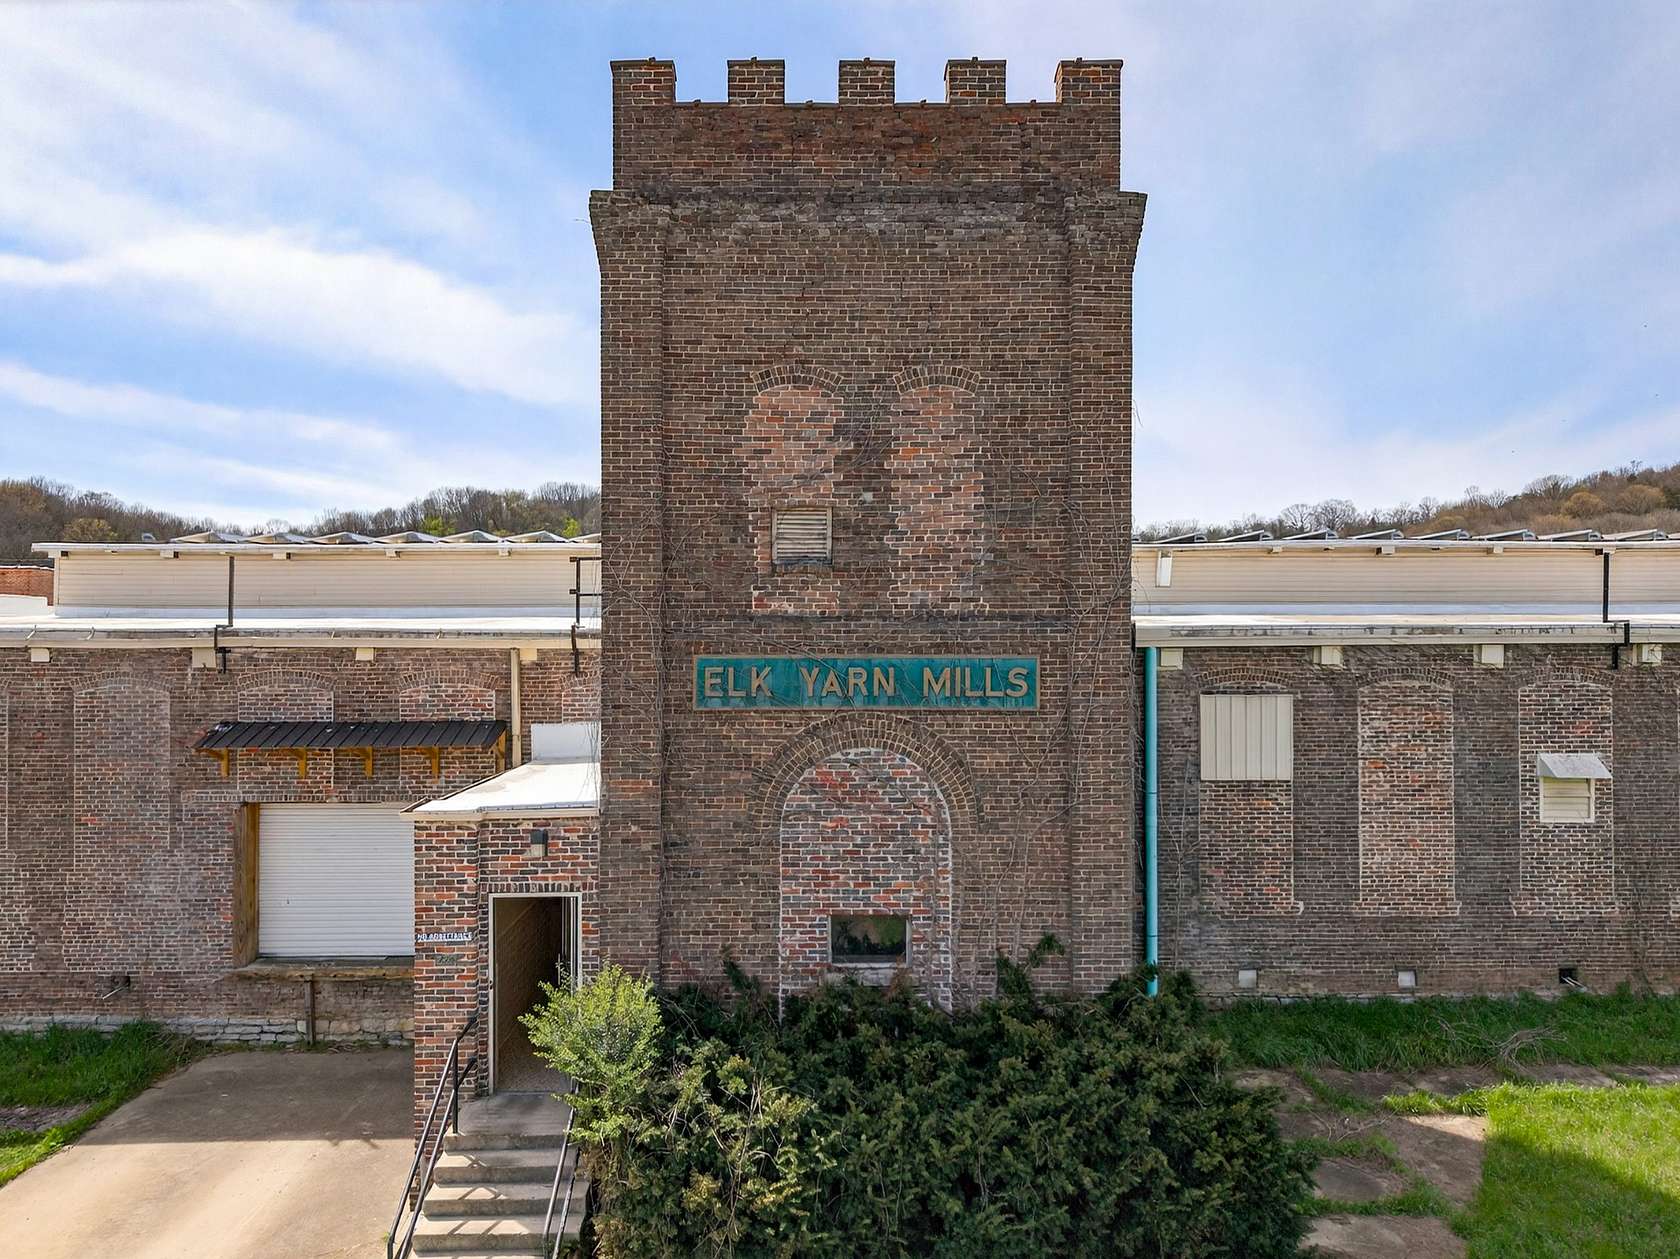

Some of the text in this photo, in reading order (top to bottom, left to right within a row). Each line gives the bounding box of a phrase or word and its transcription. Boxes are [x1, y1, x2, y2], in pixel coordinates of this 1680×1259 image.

[704, 666, 1029, 697] ELK YARN MILLS
